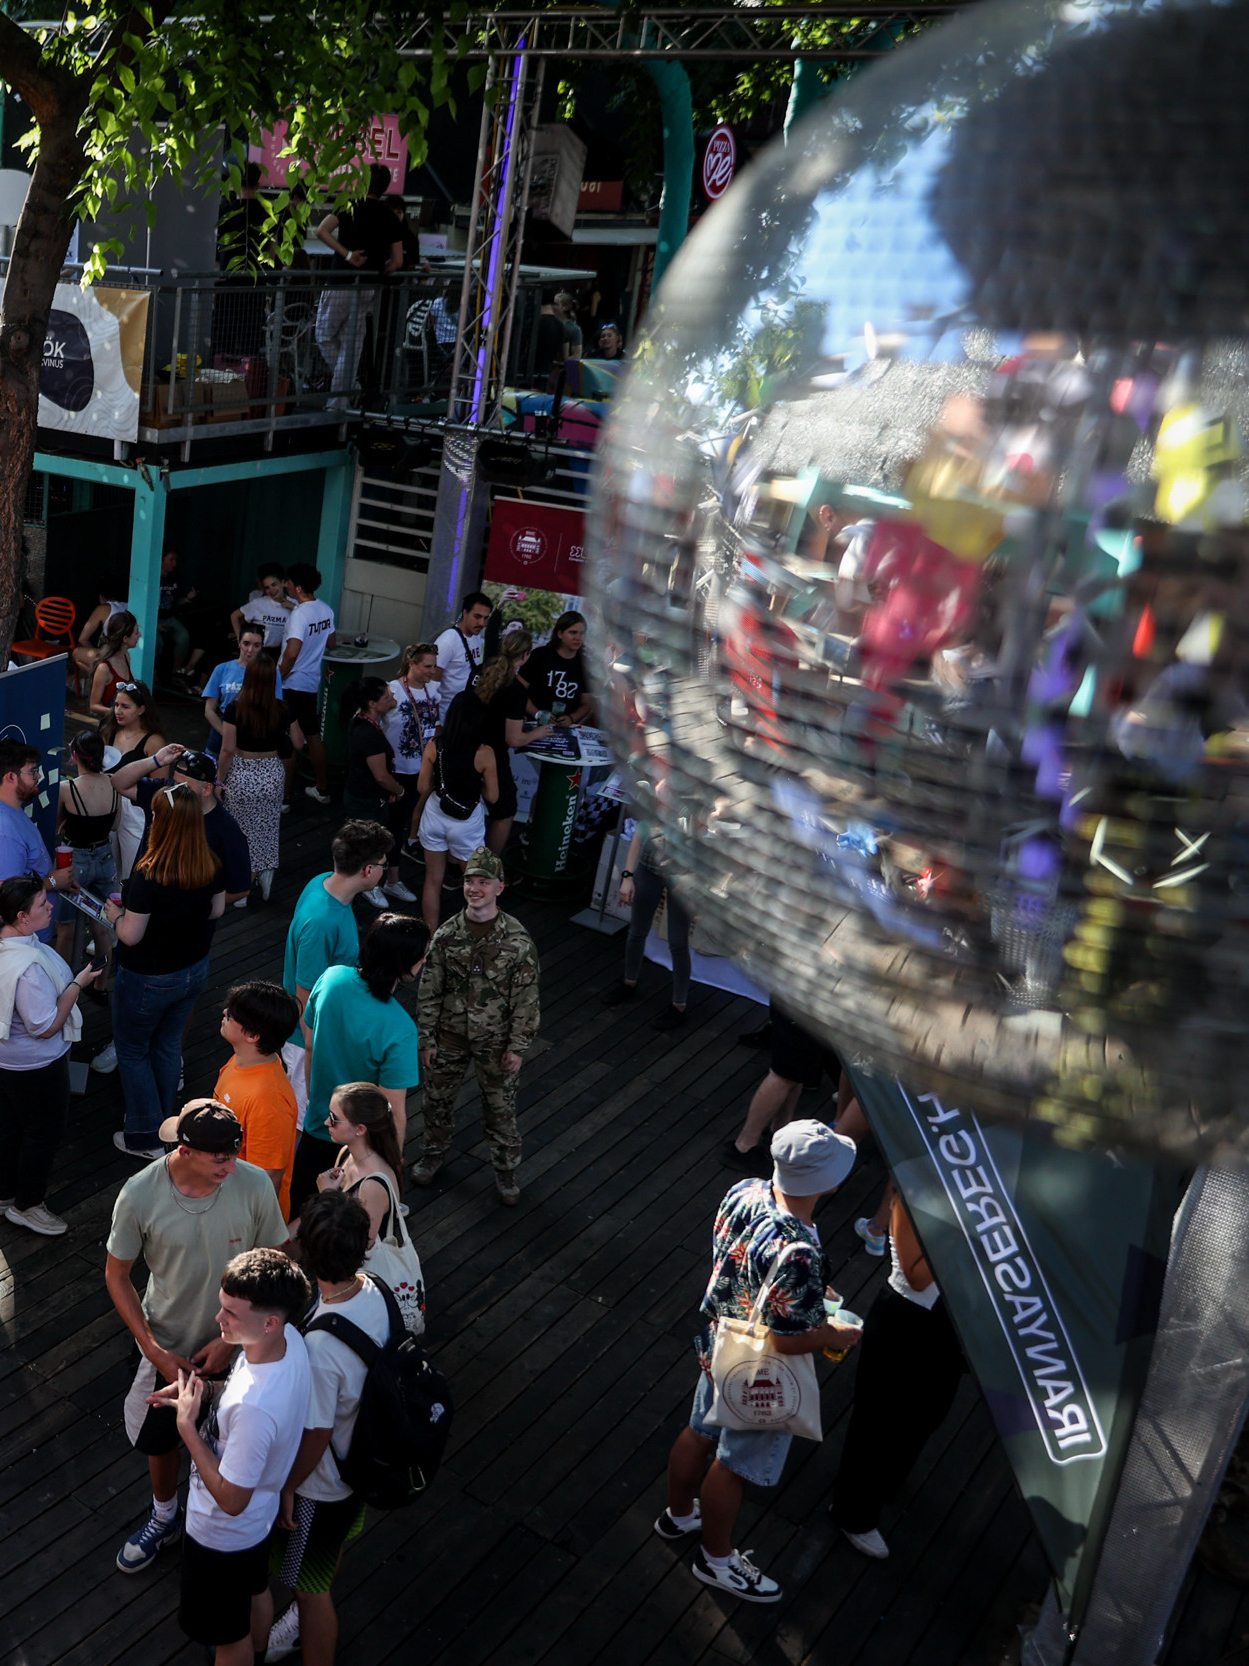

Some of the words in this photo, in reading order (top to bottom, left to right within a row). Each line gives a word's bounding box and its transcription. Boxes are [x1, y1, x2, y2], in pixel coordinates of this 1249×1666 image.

[713, 141, 731, 151] PIZZA
[41, 358, 64, 369] VINUS
[309, 618, 331, 637] TUTOR
[546, 670, 567, 687] 17
[555, 681, 579, 699] 82
[554, 795, 578, 872] Heineken
